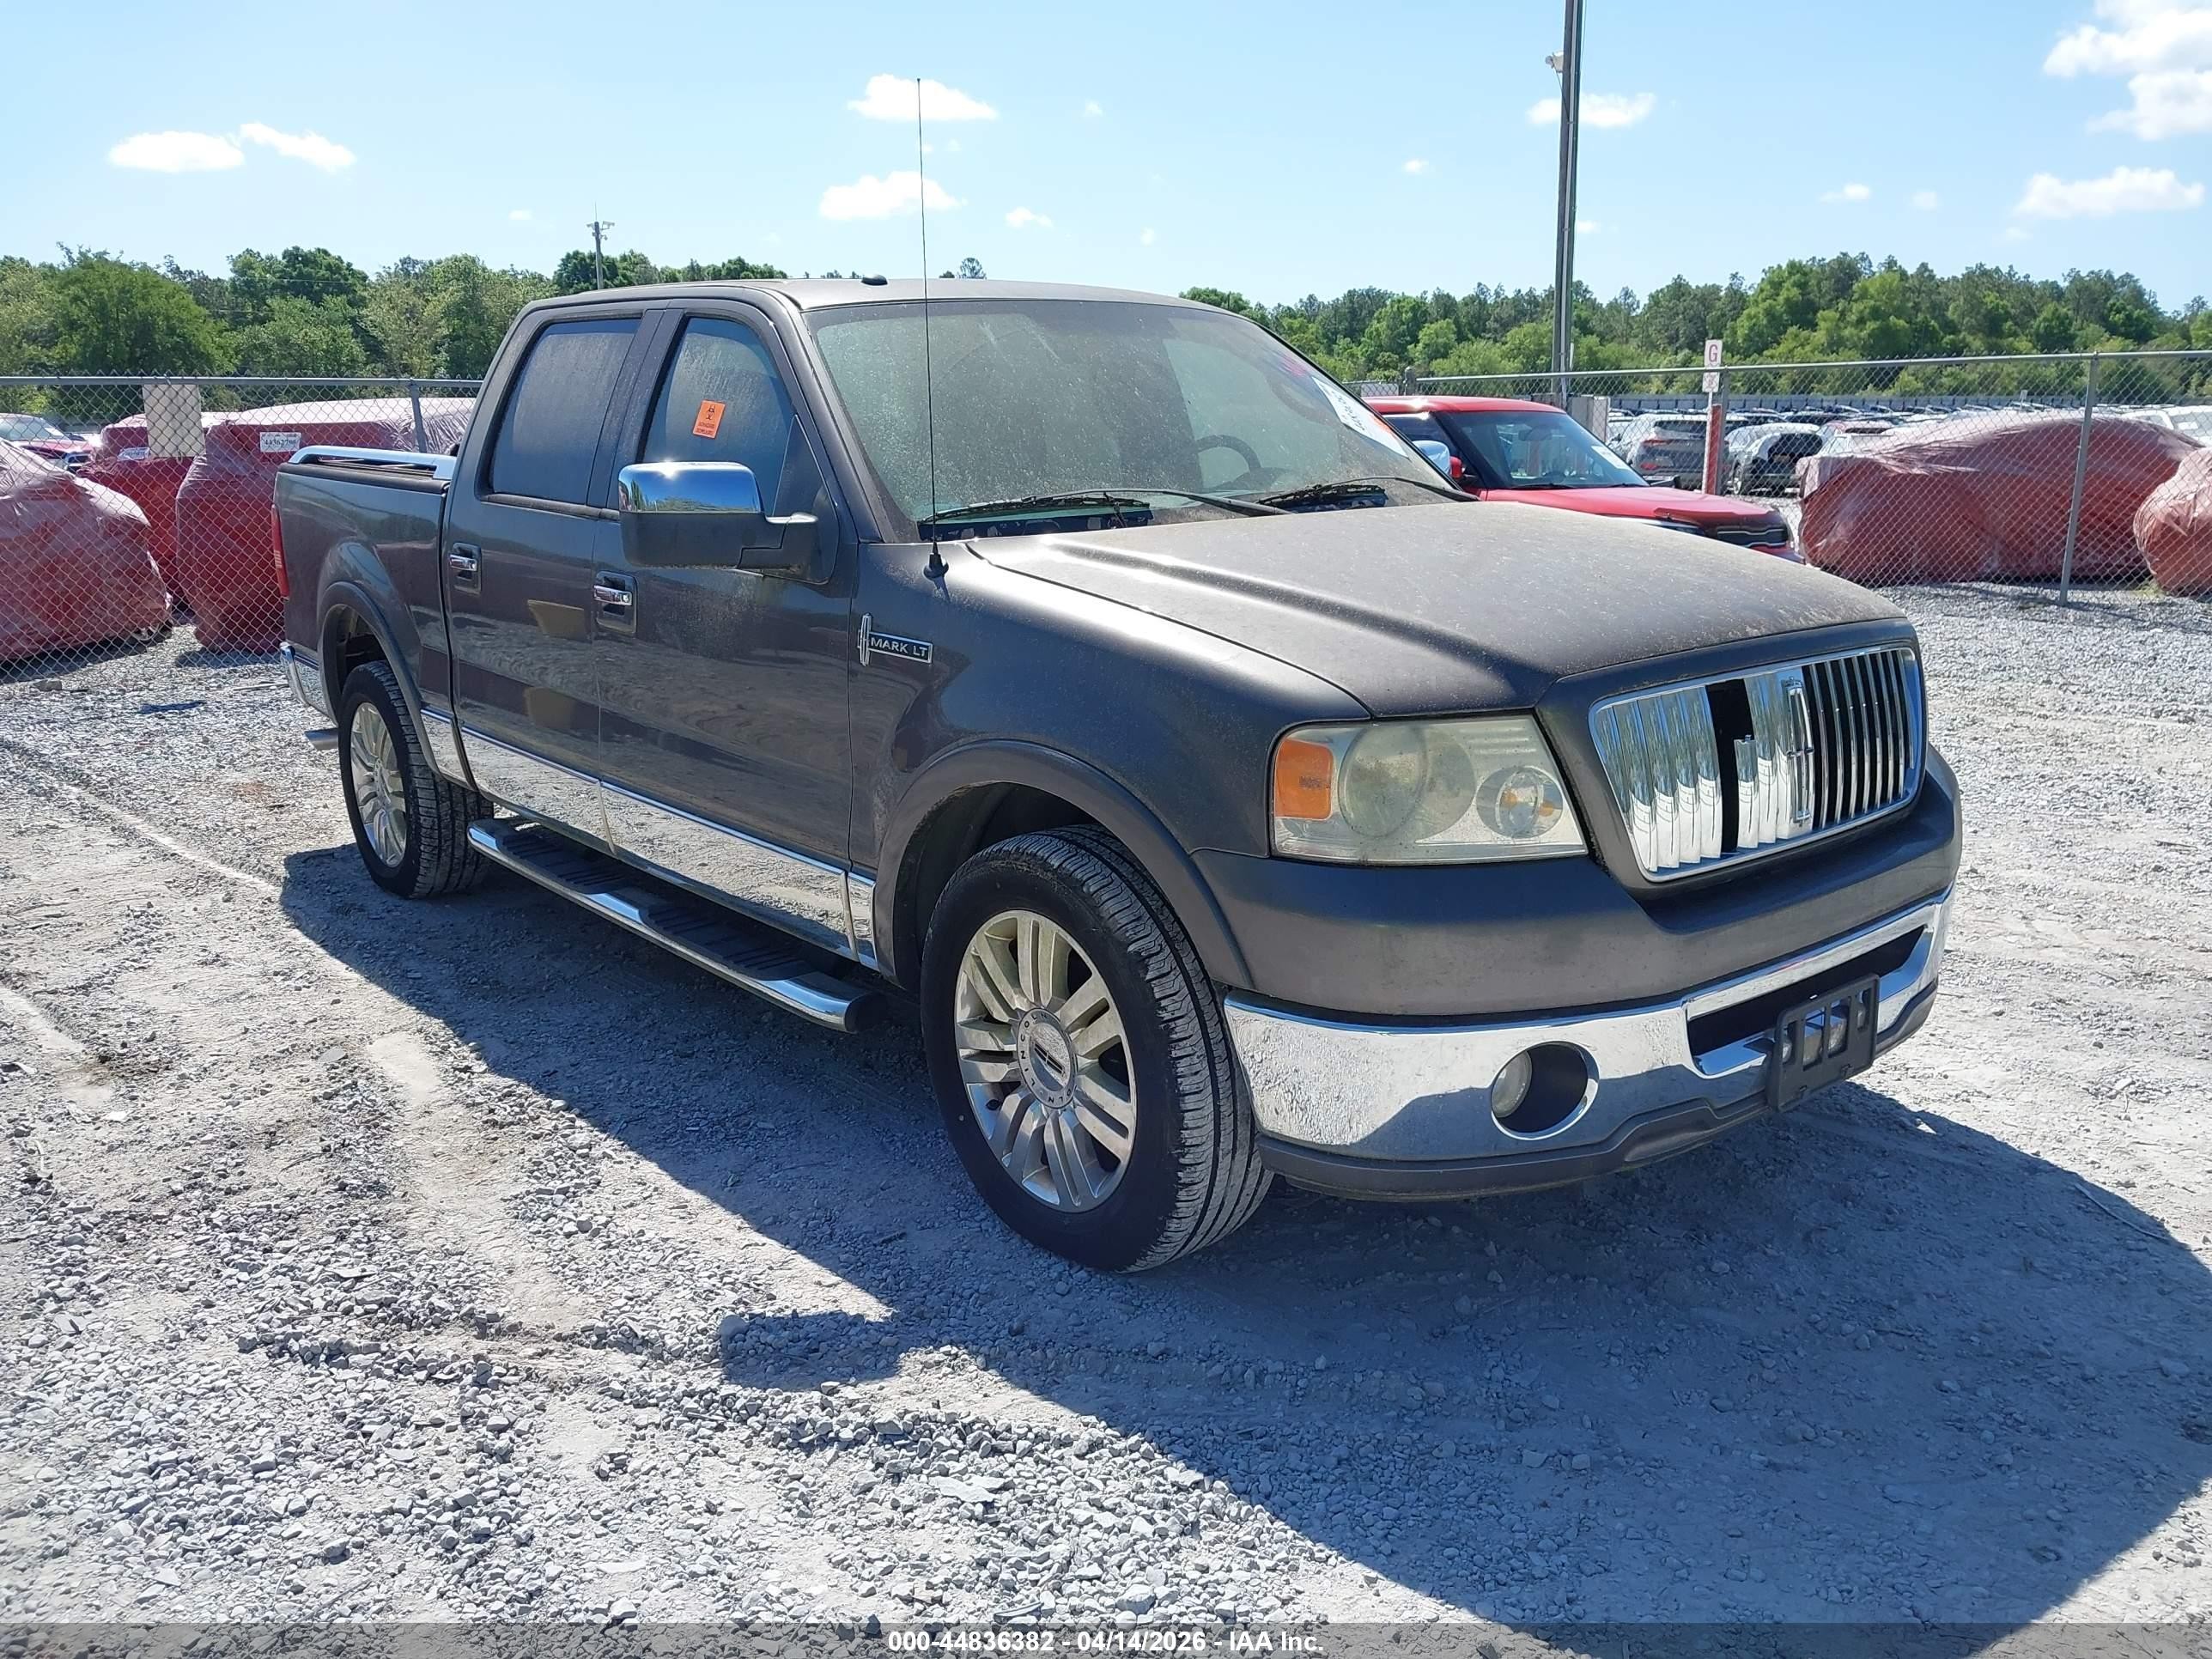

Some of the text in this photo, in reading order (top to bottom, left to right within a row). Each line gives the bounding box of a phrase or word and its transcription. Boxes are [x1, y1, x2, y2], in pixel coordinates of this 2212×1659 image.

[1708, 343, 1718, 362] G
[871, 637, 928, 657] MARK LT
[1019, 1012, 1048, 1086] LINCOLN
